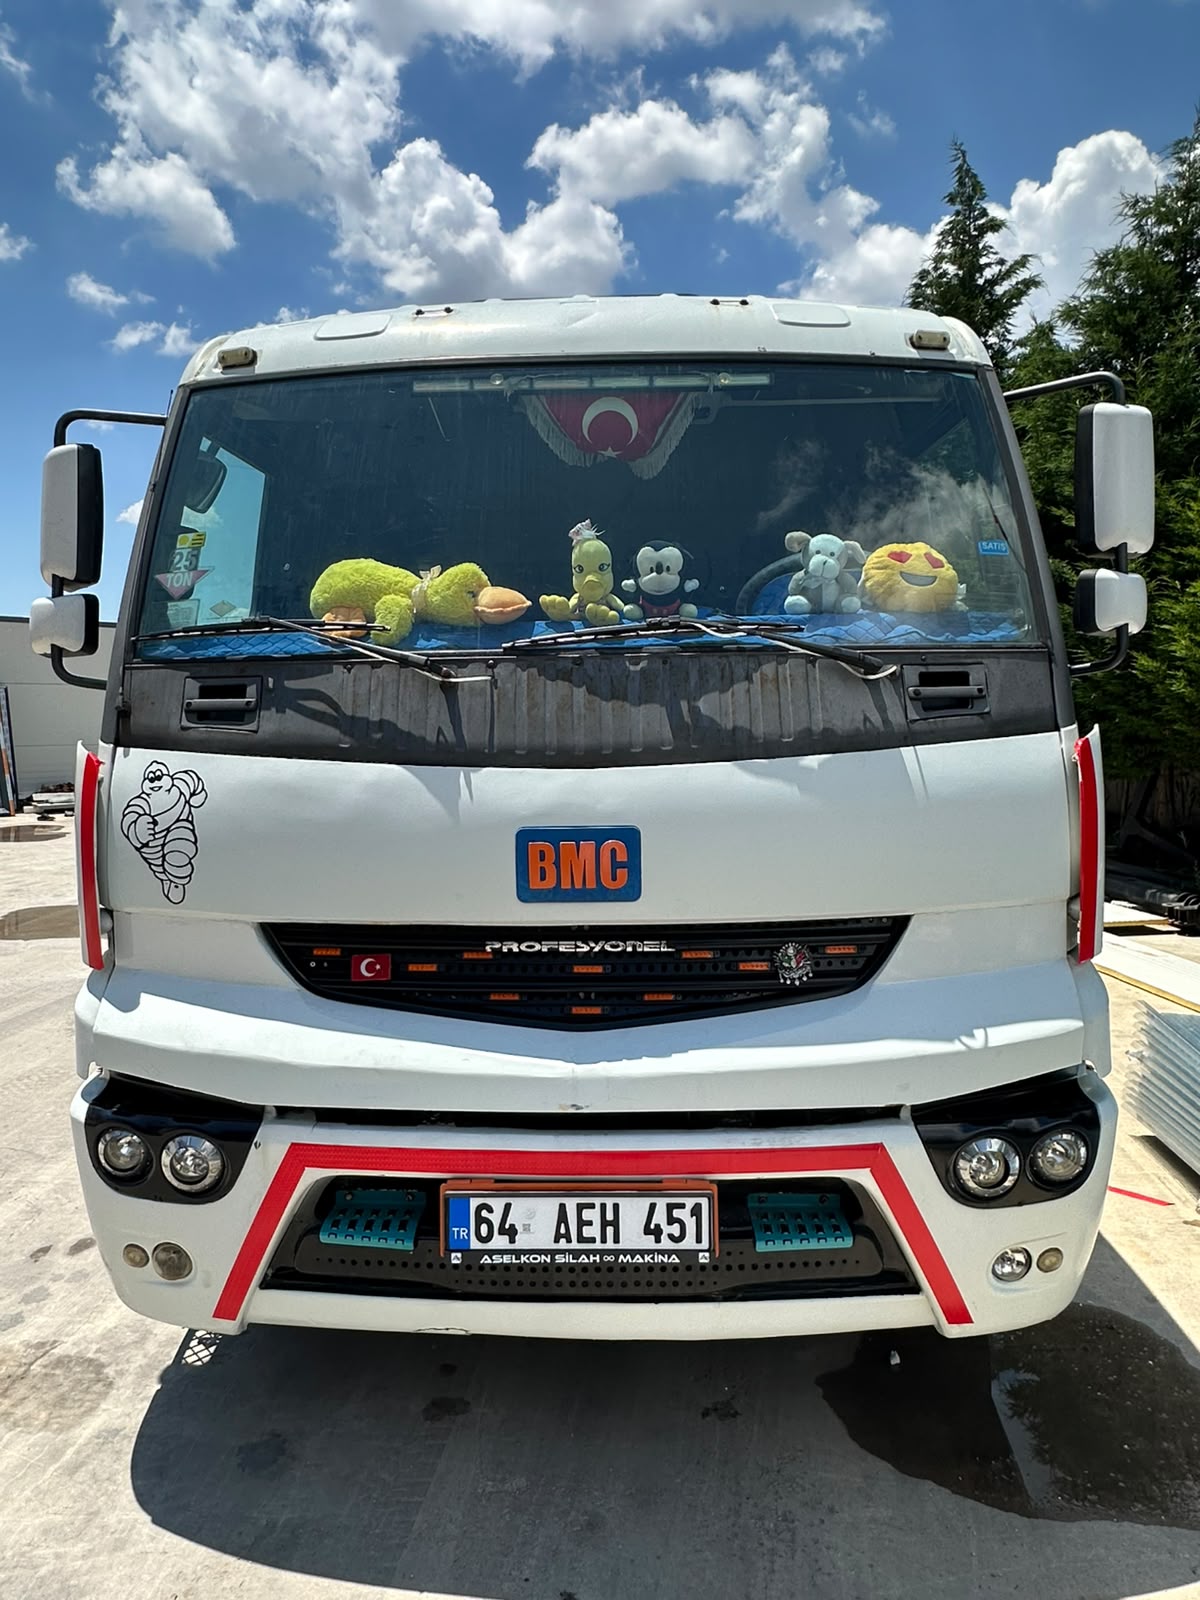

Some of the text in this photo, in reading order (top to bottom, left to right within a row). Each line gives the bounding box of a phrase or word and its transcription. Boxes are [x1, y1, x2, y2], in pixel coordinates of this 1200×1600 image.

[171, 550, 198, 571] 25
[165, 571, 194, 588] TON
[528, 839, 628, 890] BMC
[485, 940, 676, 953] PROFESYONEL
[474, 1202, 703, 1245] 64 AEH 451
[452, 1227, 468, 1240] TR
[480, 1251, 681, 1264] ASELKON SİLAH MAKİNA
